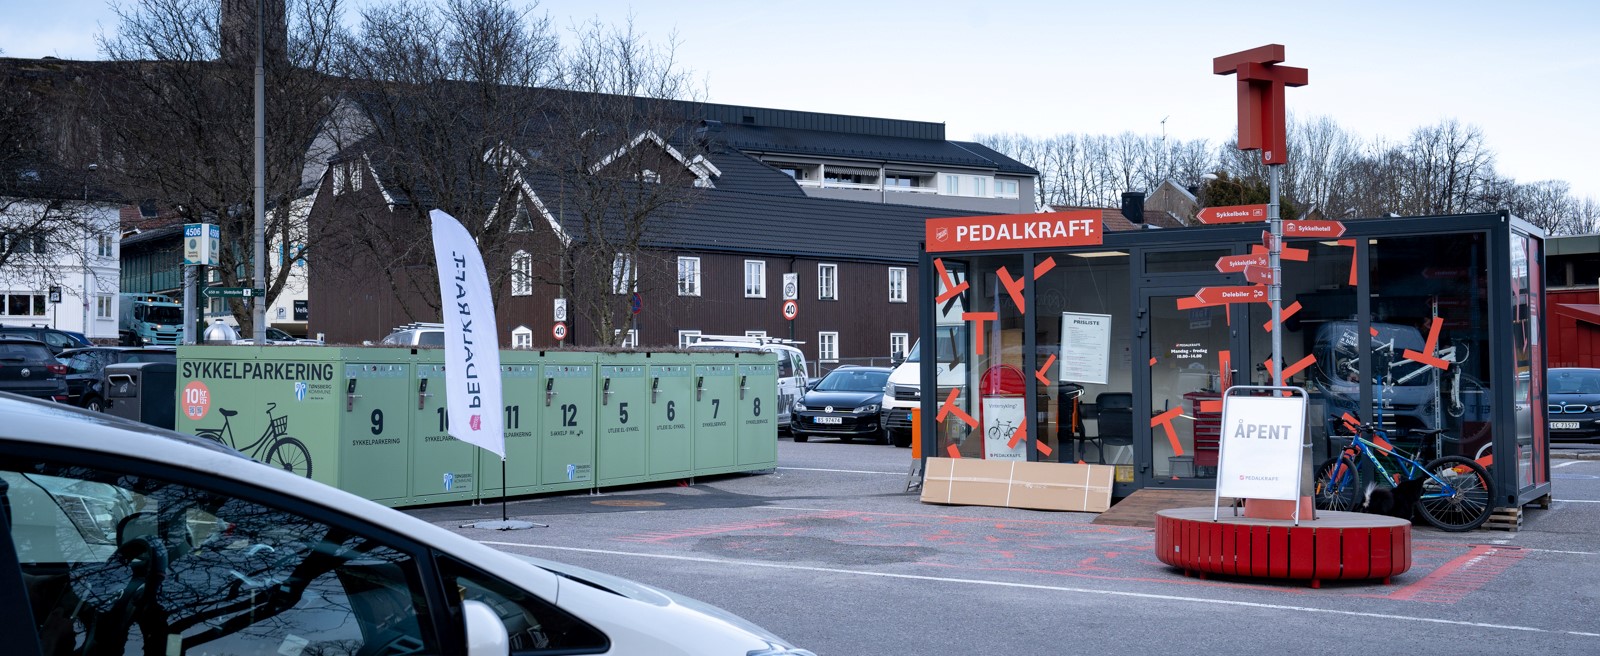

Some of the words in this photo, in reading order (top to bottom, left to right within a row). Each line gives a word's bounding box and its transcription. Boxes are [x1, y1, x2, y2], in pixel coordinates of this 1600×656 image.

[185, 227, 201, 236] 4506
[956, 218, 1094, 242] PEDALKRAFT
[785, 305, 795, 314] 40
[556, 327, 565, 335] 40
[182, 361, 334, 381] SYKKELPARKERING
[185, 388, 199, 404] 10
[199, 388, 207, 397] kr
[505, 405, 519, 429] 11
[560, 403, 577, 427] 12
[619, 402, 629, 424] 5
[666, 400, 676, 421] 6
[711, 398, 720, 419] 7
[753, 397, 761, 417] 8
[371, 408, 384, 435] 9
[1234, 418, 1292, 440] ÅPENT
[352, 438, 401, 446] SYKKELPARKERING
